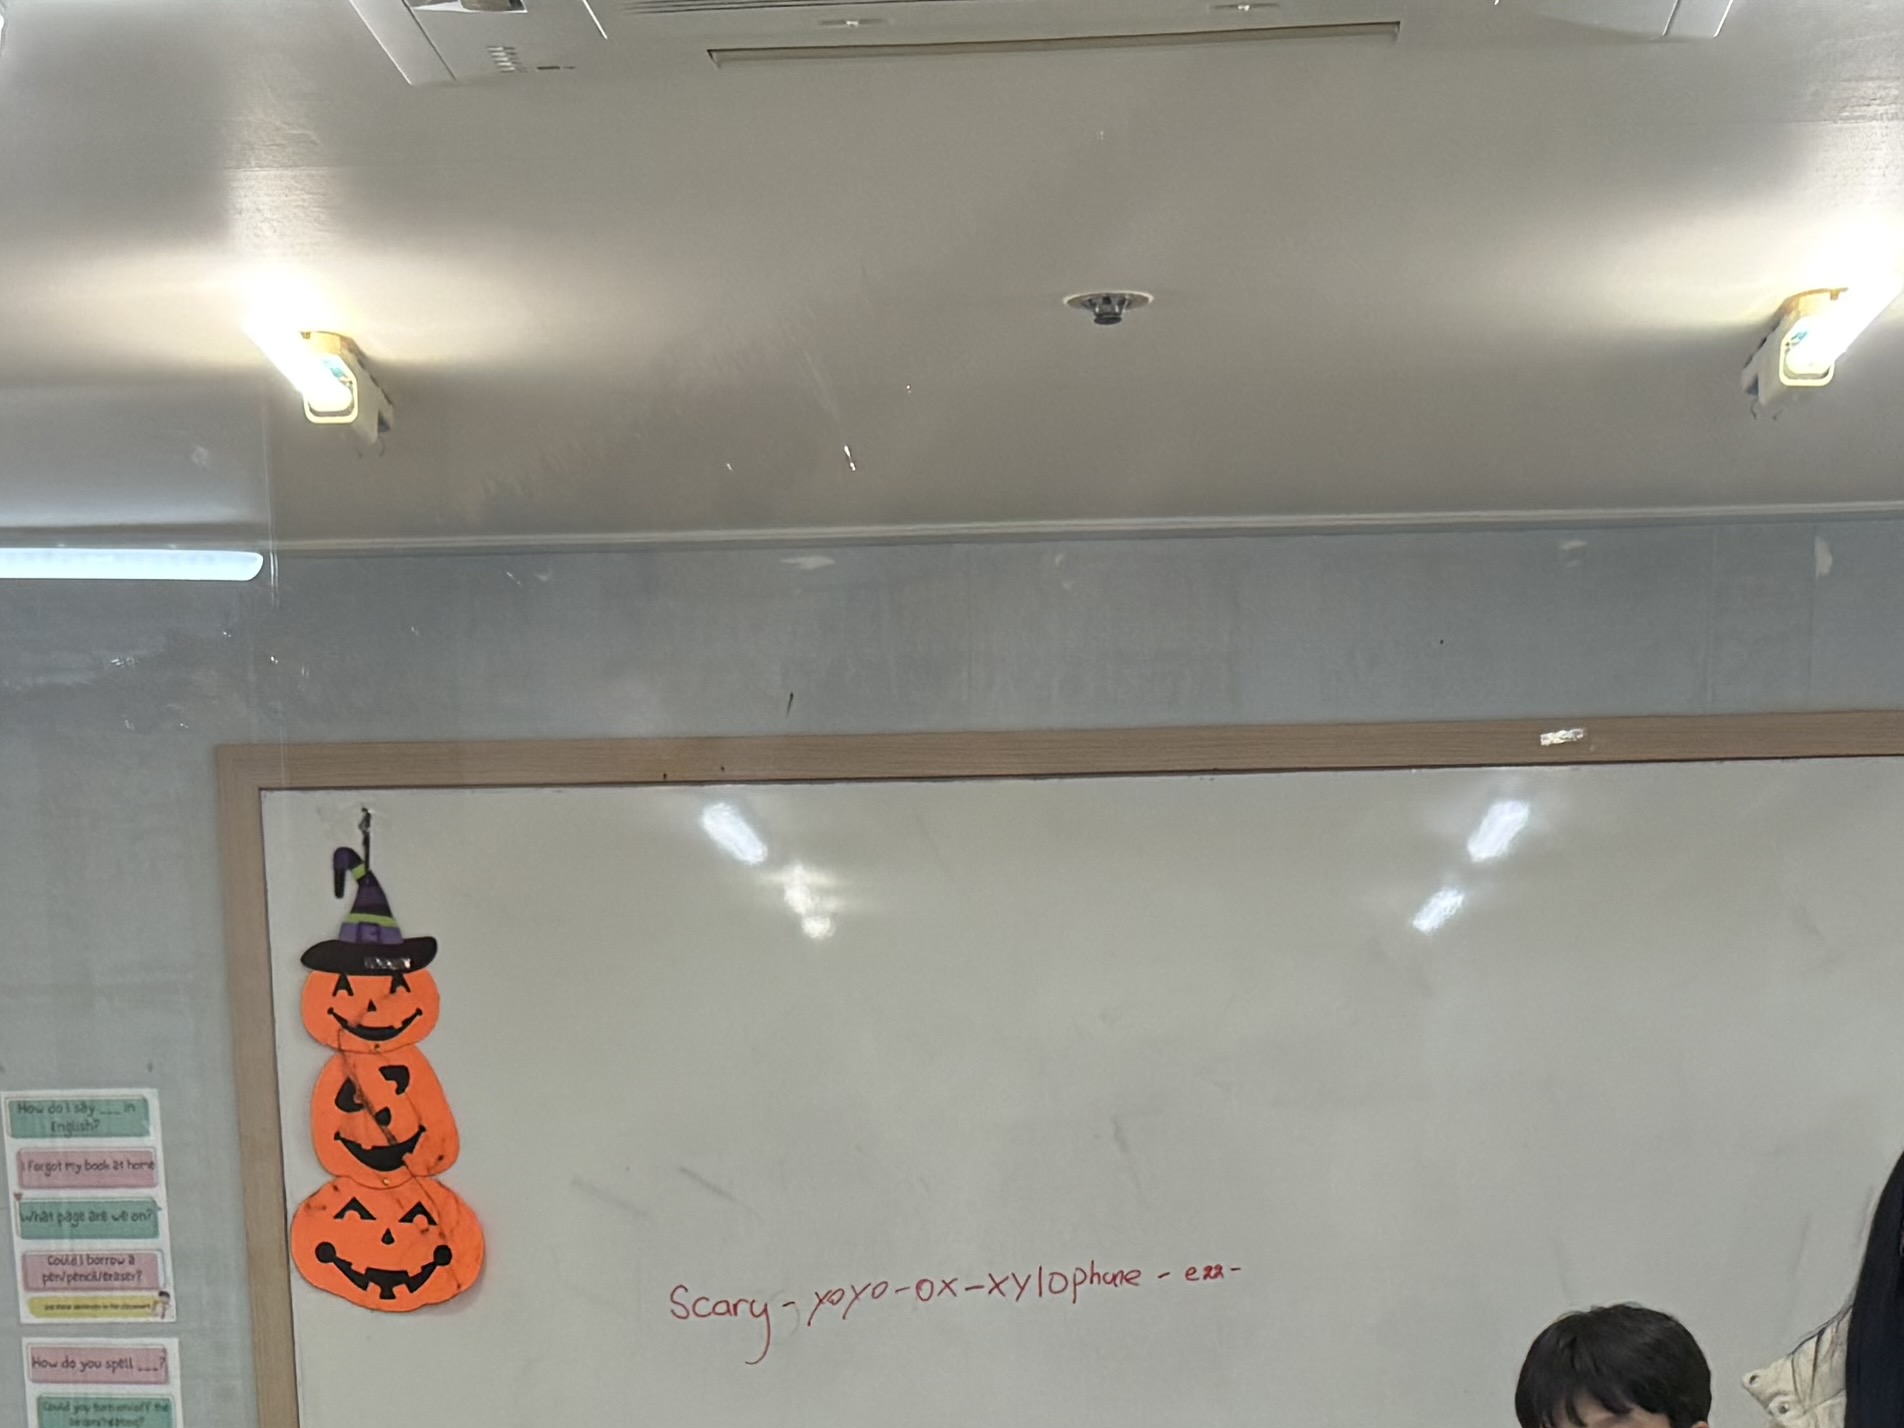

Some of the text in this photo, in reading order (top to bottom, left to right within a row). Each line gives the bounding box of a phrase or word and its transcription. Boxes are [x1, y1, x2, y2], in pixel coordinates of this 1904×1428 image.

[18, 1104, 43, 1114] How
[48, 1103, 65, 1114] do
[74, 1104, 95, 1116] say
[84, 1160, 109, 1171] book
[58, 1212, 85, 1227] page
[32, 1358, 58, 1368] How
[62, 1355, 76, 1368] do
[80, 1359, 102, 1372] you
